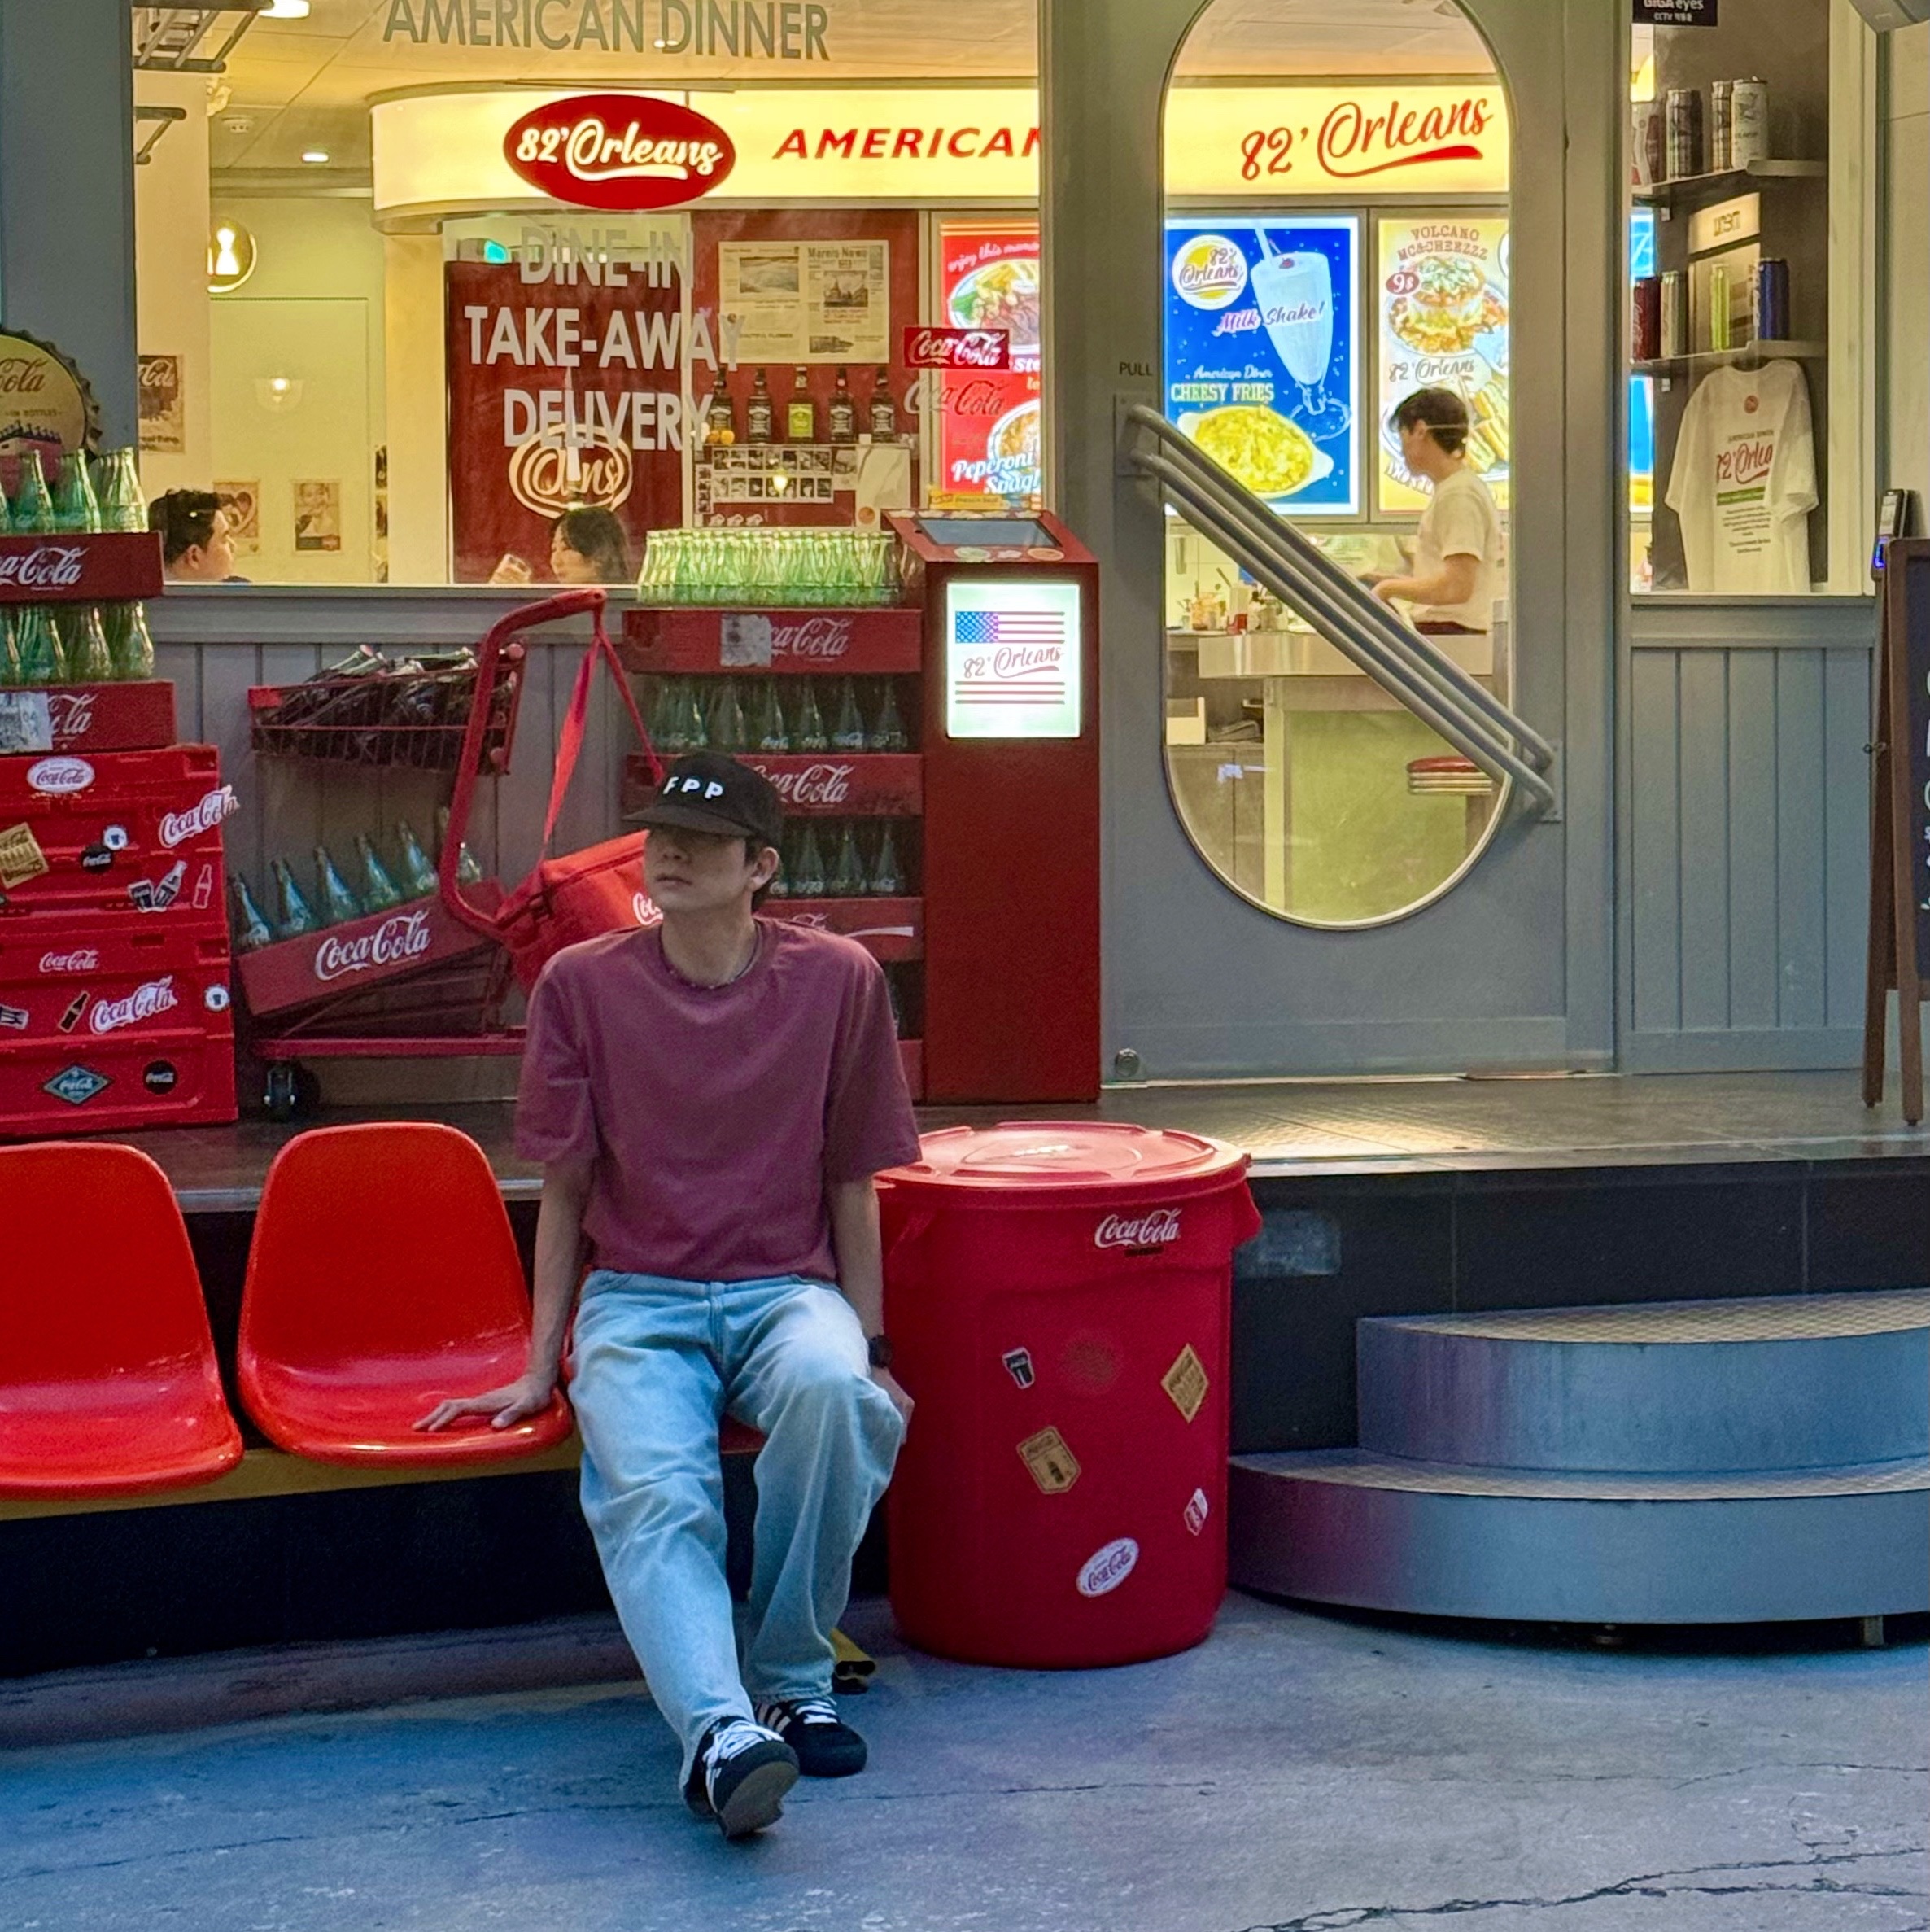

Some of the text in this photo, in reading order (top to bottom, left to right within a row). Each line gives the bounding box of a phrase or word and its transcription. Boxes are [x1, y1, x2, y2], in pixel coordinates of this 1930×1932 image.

[382, 0, 831, 61] AMERICAN DINNER
[565, 118, 723, 181] Orleans
[1317, 98, 1494, 178] Orleans
[519, 227, 694, 289] DINE-IN
[1411, 225, 1480, 241] VOLCANO
[465, 306, 744, 372] TAKE-AWAY
[1119, 361, 1153, 376] PULL
[504, 388, 714, 452] DELIVERY
[1170, 382, 1275, 403] CHEESY FRIES
[993, 646, 1065, 679] Orleans
[1094, 1208, 1182, 1249] Coca-Cola
